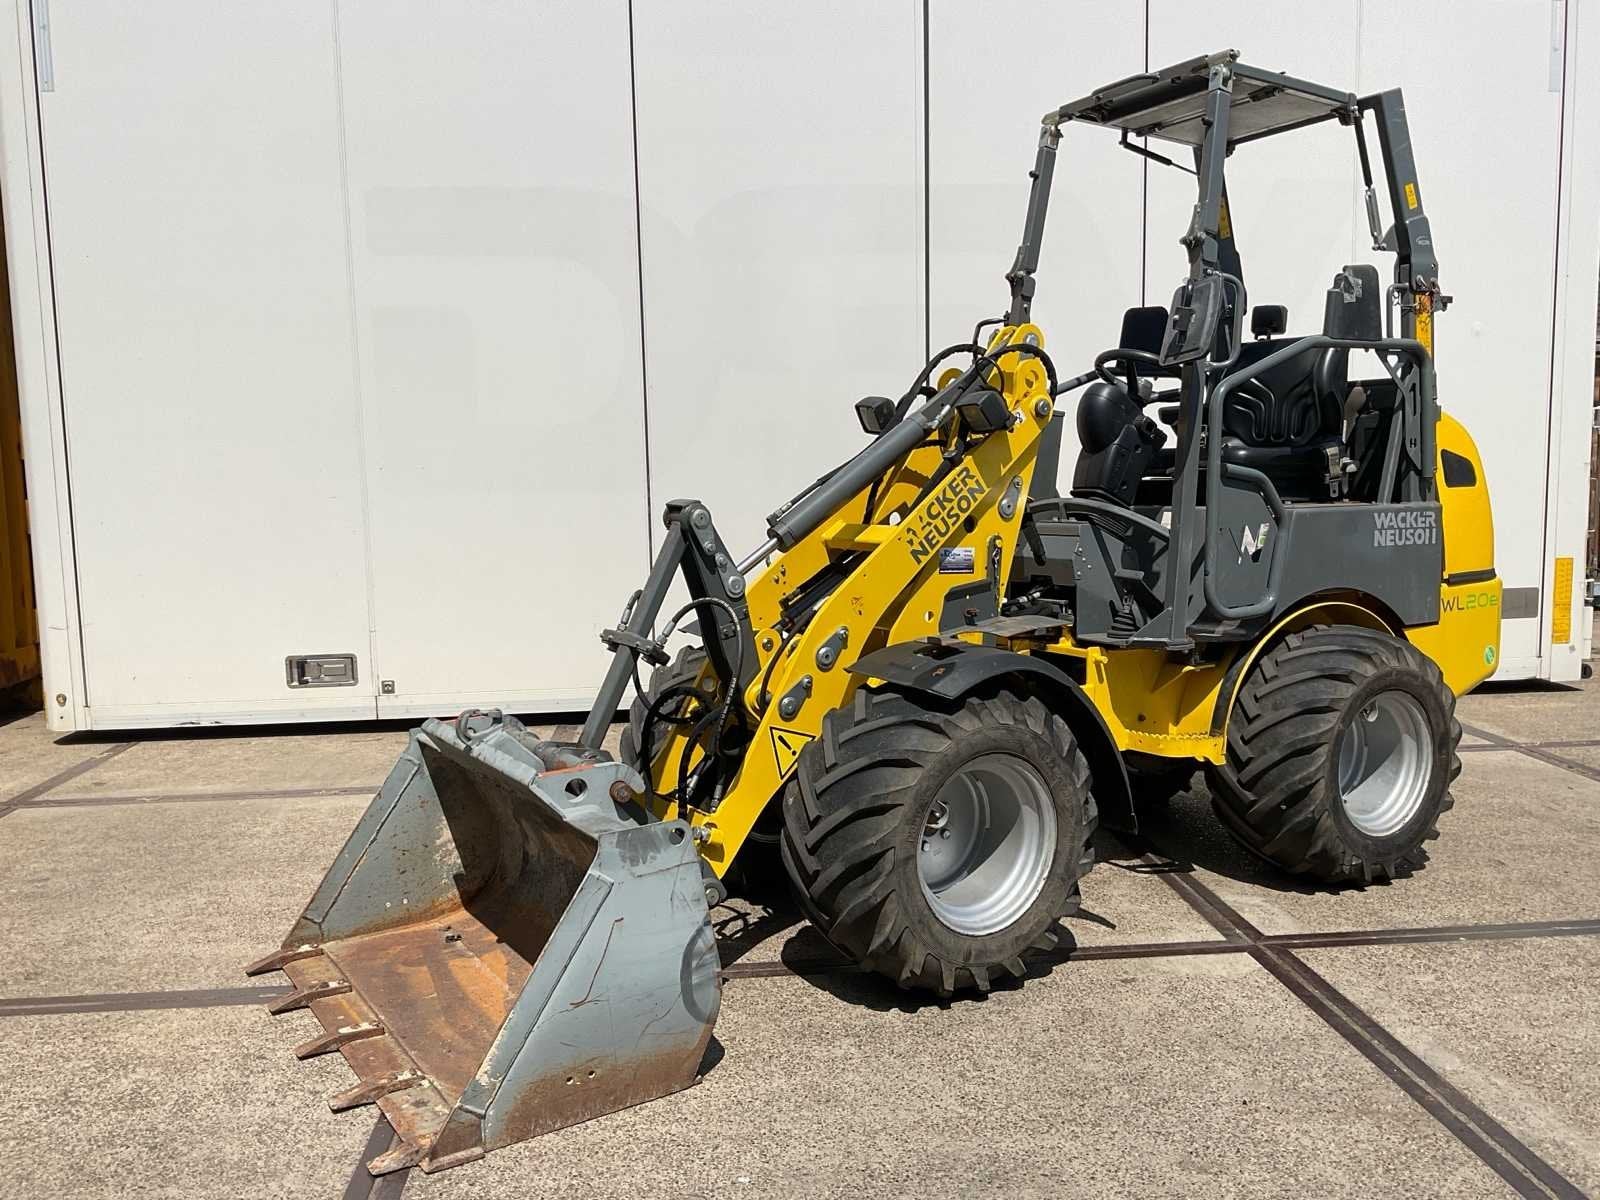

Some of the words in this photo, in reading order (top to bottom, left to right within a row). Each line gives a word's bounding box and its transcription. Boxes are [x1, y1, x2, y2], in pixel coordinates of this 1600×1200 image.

[910, 479, 986, 566] NEUSON
[1373, 511, 1436, 529] WACKER
[1441, 593, 1498, 613] WL20e
